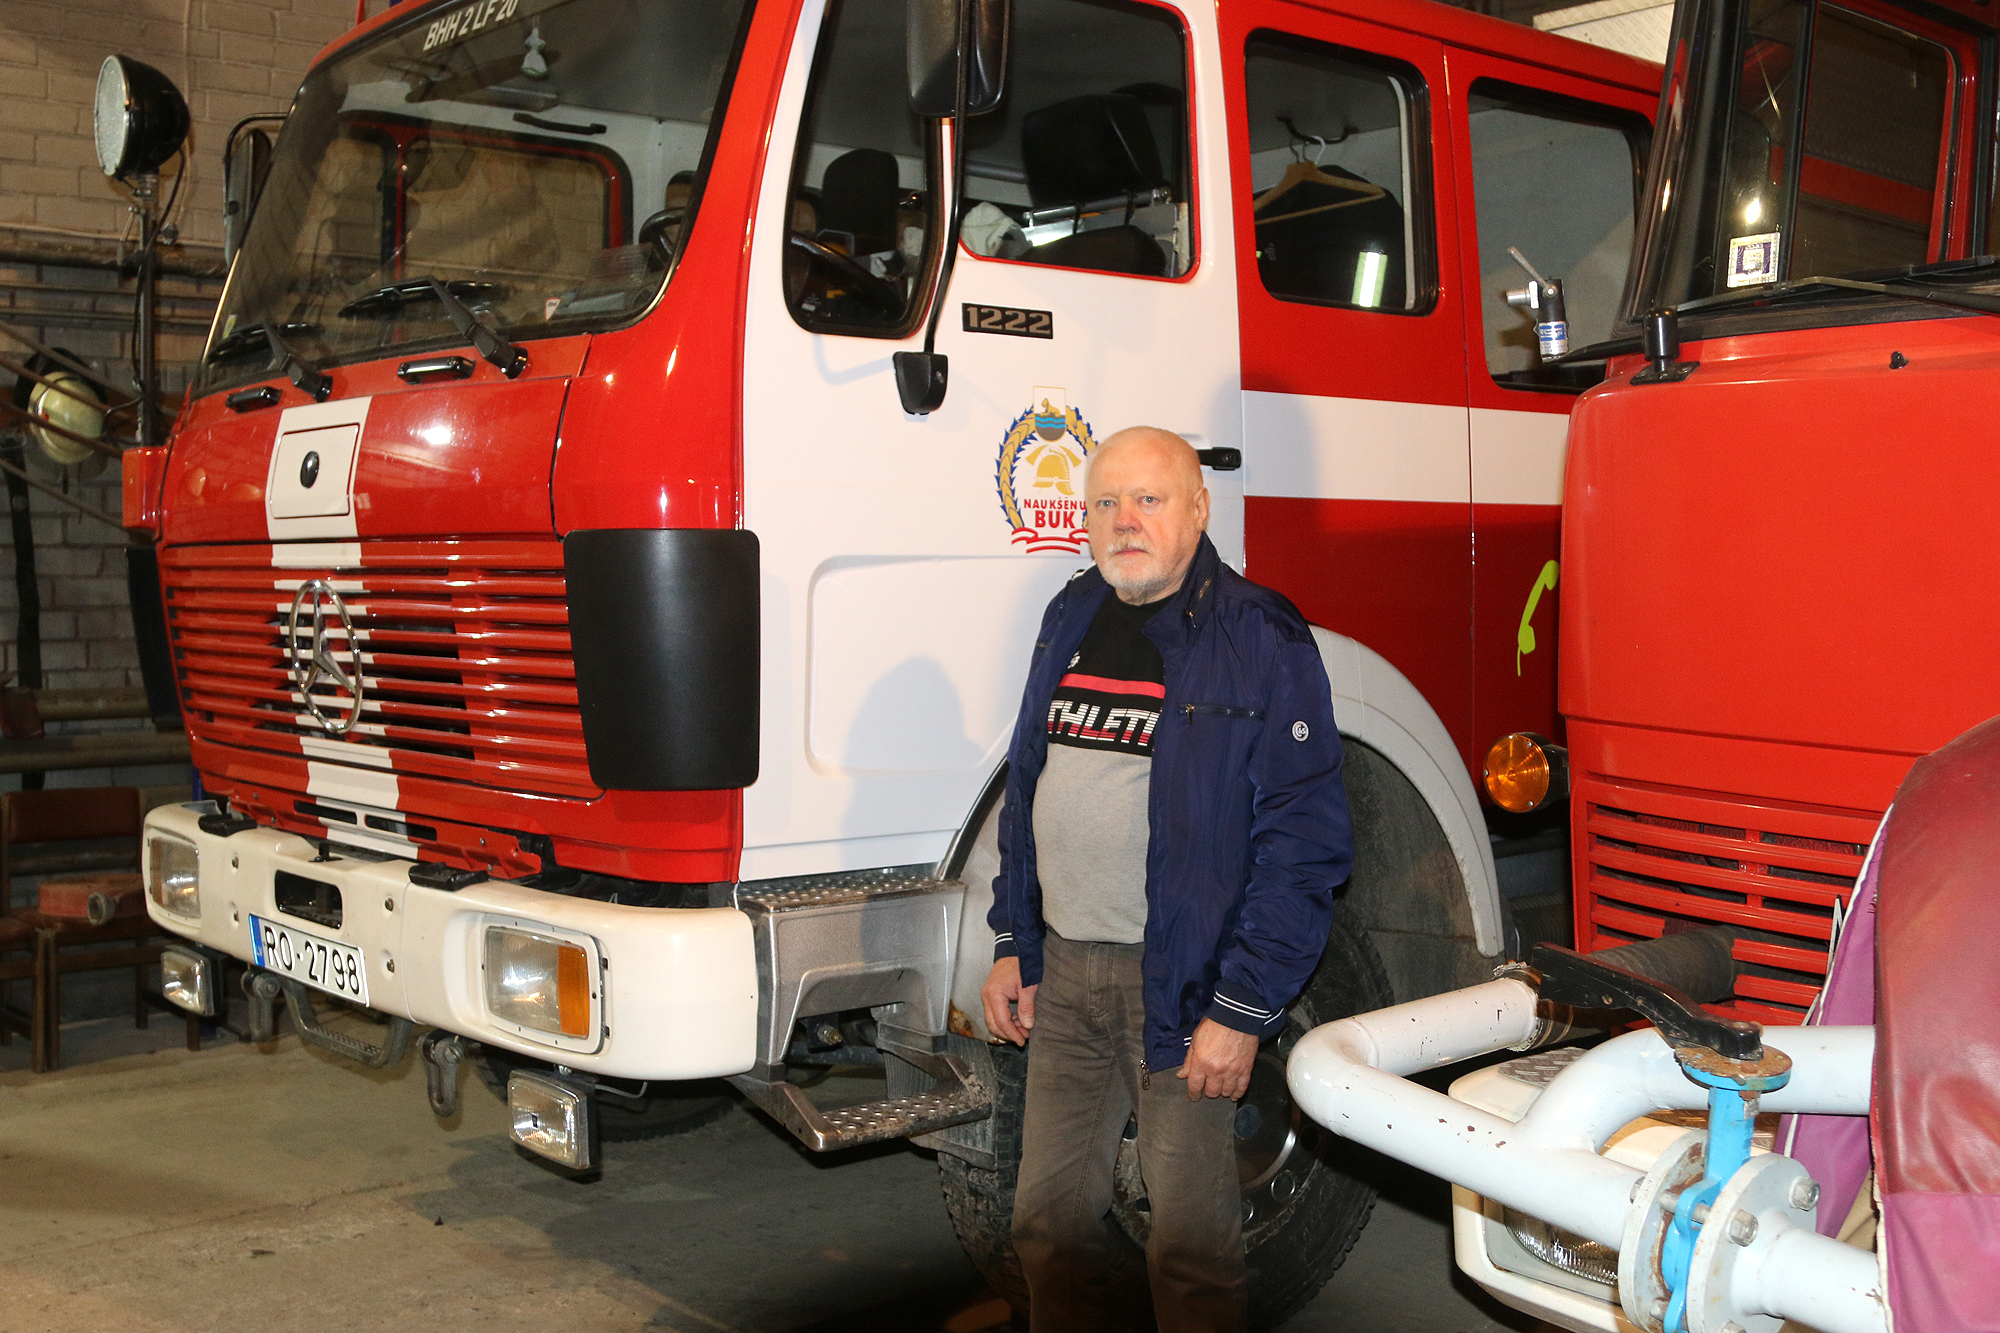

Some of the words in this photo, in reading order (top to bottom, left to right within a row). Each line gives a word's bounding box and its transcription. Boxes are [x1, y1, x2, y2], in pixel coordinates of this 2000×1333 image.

[423, 11, 462, 51] BHH
[458, 6, 475, 36] 2
[472, 0, 499, 30] LF
[967, 306, 1050, 334] 1222
[1035, 510, 1076, 529] BUK
[264, 925, 361, 995] RO-2798
